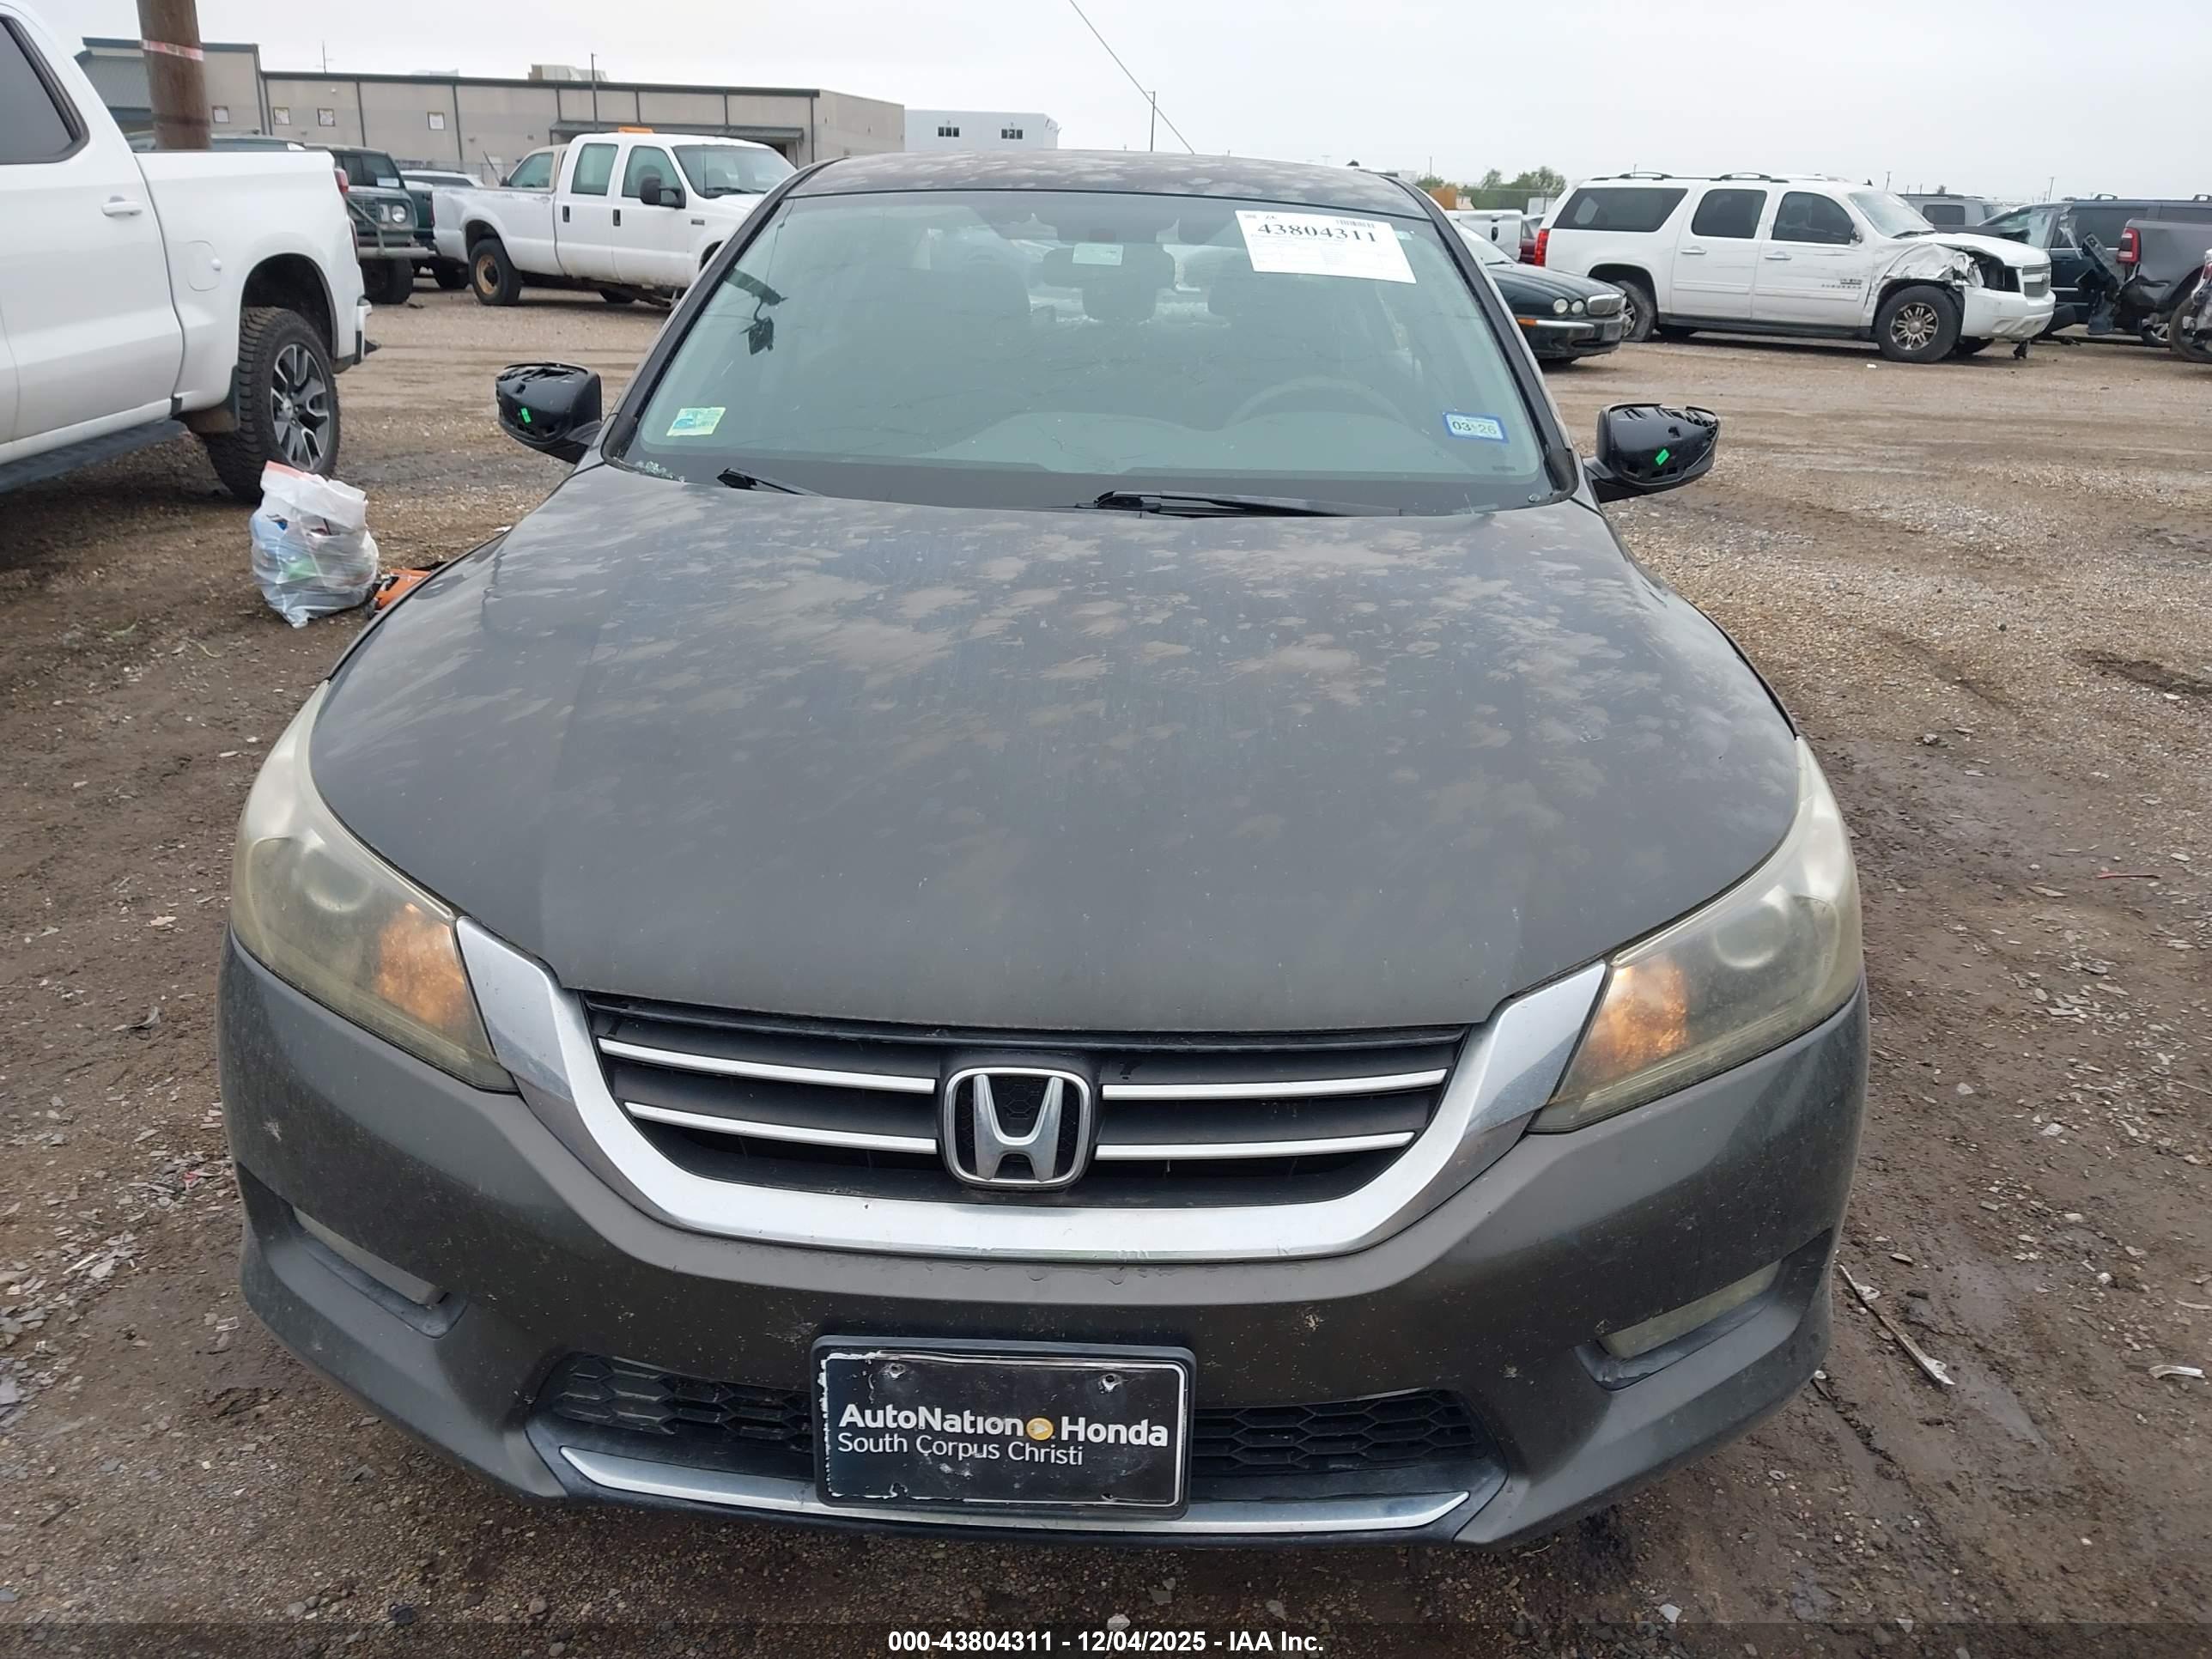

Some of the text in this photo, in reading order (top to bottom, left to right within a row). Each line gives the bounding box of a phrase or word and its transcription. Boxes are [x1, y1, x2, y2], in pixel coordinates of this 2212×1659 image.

[1257, 222, 1376, 243] 43804311
[838, 1403, 1169, 1447] AutoNation Honda
[837, 1432, 1084, 1466] South Corpus Christi
